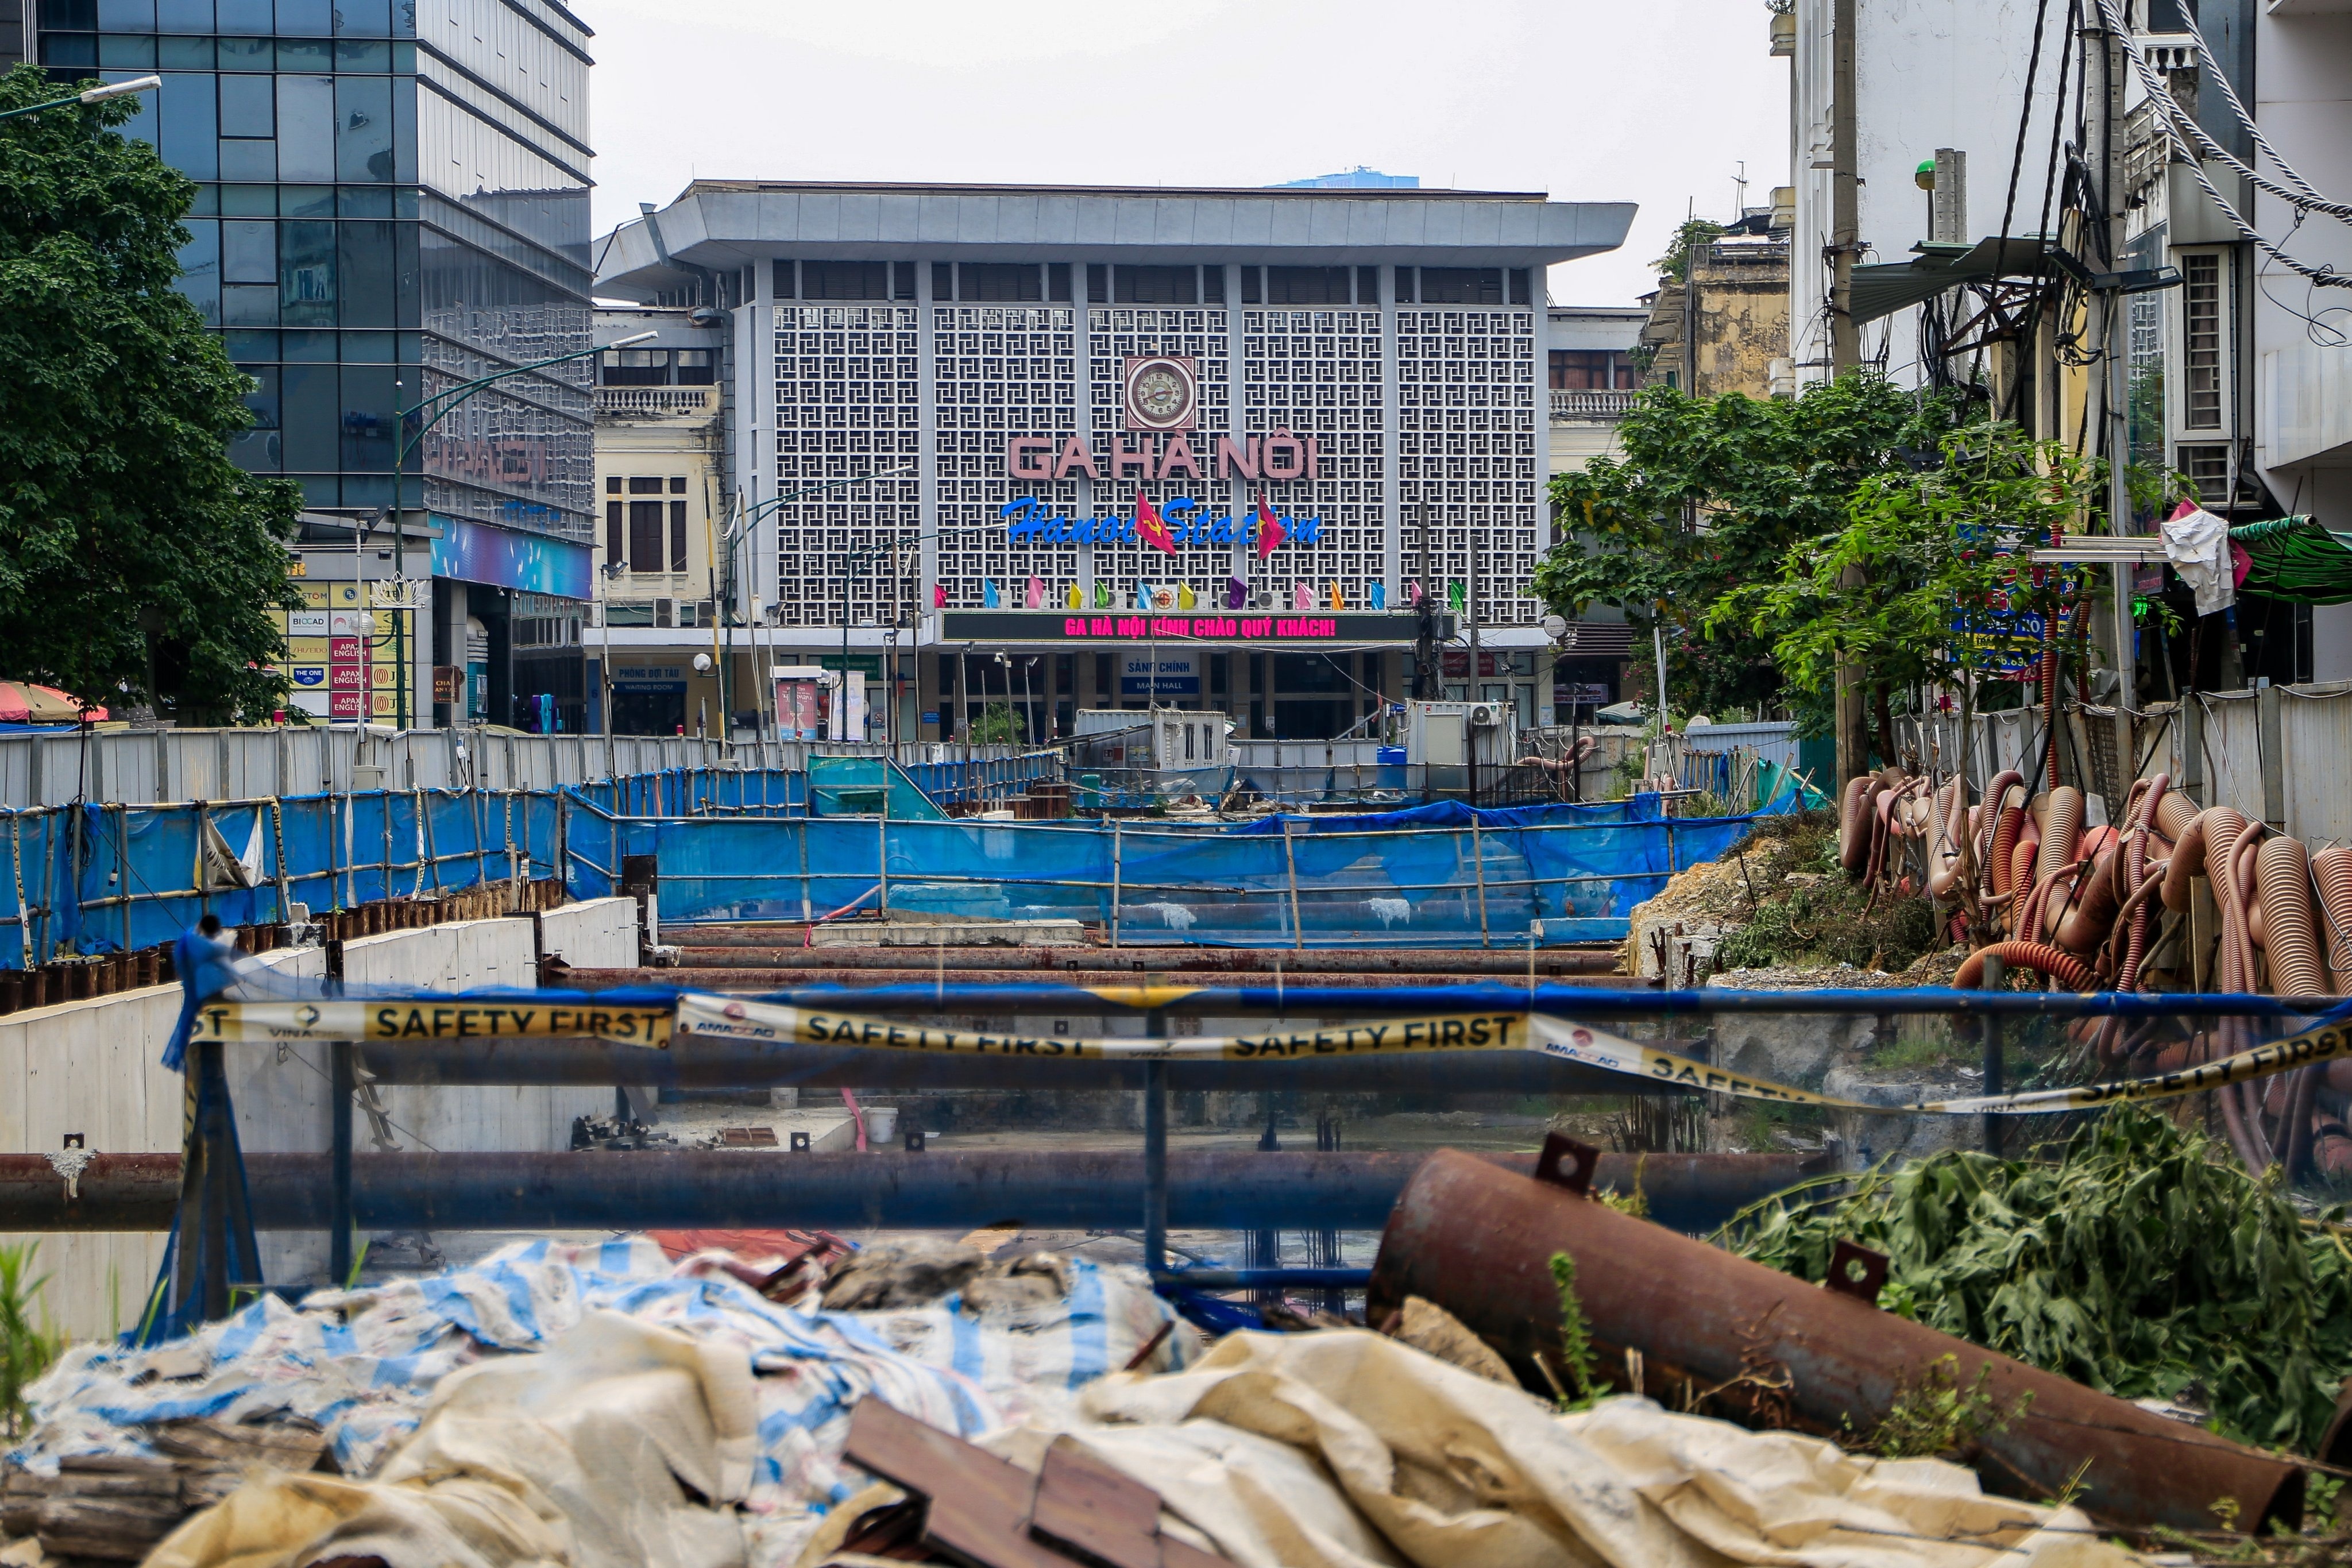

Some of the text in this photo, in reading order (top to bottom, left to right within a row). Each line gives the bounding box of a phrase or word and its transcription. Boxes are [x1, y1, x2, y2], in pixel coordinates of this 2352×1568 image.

[1009, 427, 1317, 482] GA HÀ NỘI
[1159, 498, 1323, 544] Staton
[1065, 616, 1335, 639] GA HÀ NỘI KÍNH CHÀO QUÝ KHÁCH!
[389, 671, 409, 681] JL
[619, 667, 679, 680] PHÒNG ĐỢI TÀU
[1159, 661, 1189, 673] CHÍNH
[389, 698, 410, 709] JL
[377, 1009, 659, 1042] SAFETY FIRST
[808, 1017, 958, 1051] SAFETY
[1234, 1015, 1517, 1057] SAFETY FIRST
